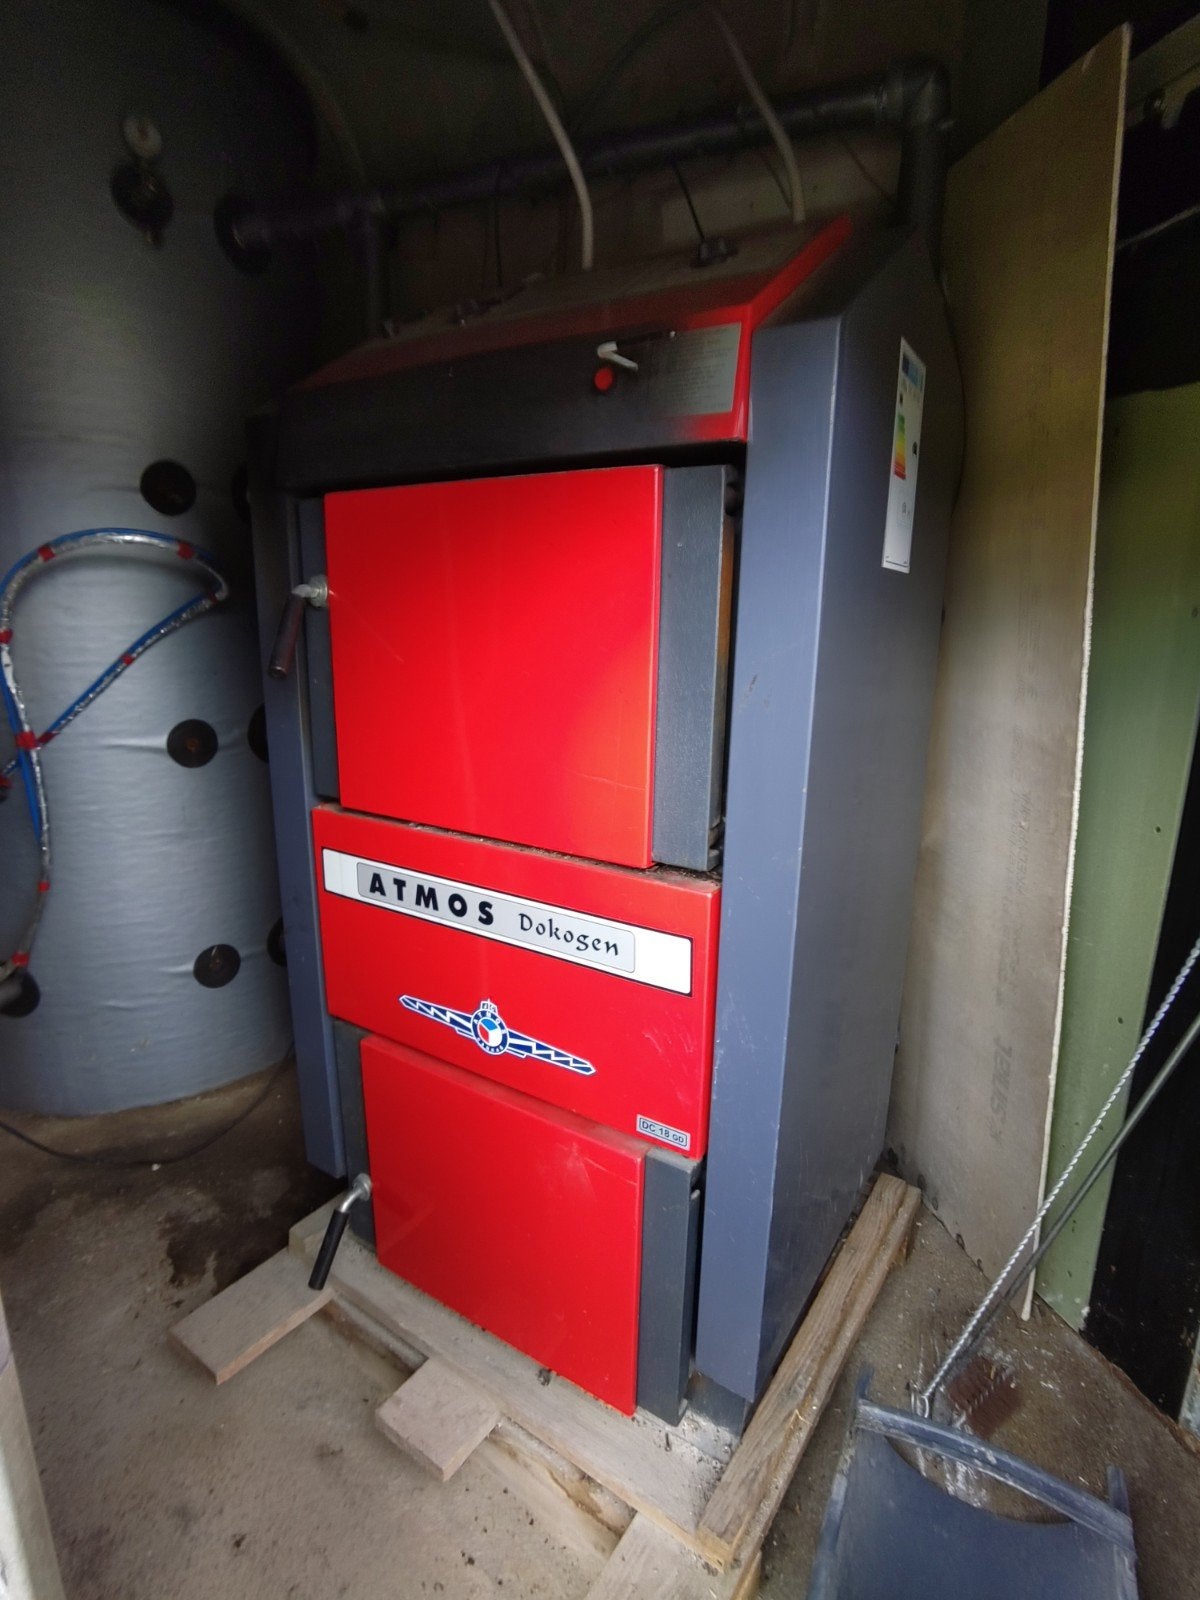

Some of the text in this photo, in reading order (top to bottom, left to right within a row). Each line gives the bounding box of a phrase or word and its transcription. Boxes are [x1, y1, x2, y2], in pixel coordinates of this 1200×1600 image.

[369, 872, 619, 957] ATMOS Dokogen
[642, 1120, 656, 1132] DC
[659, 1128, 670, 1138] 18
